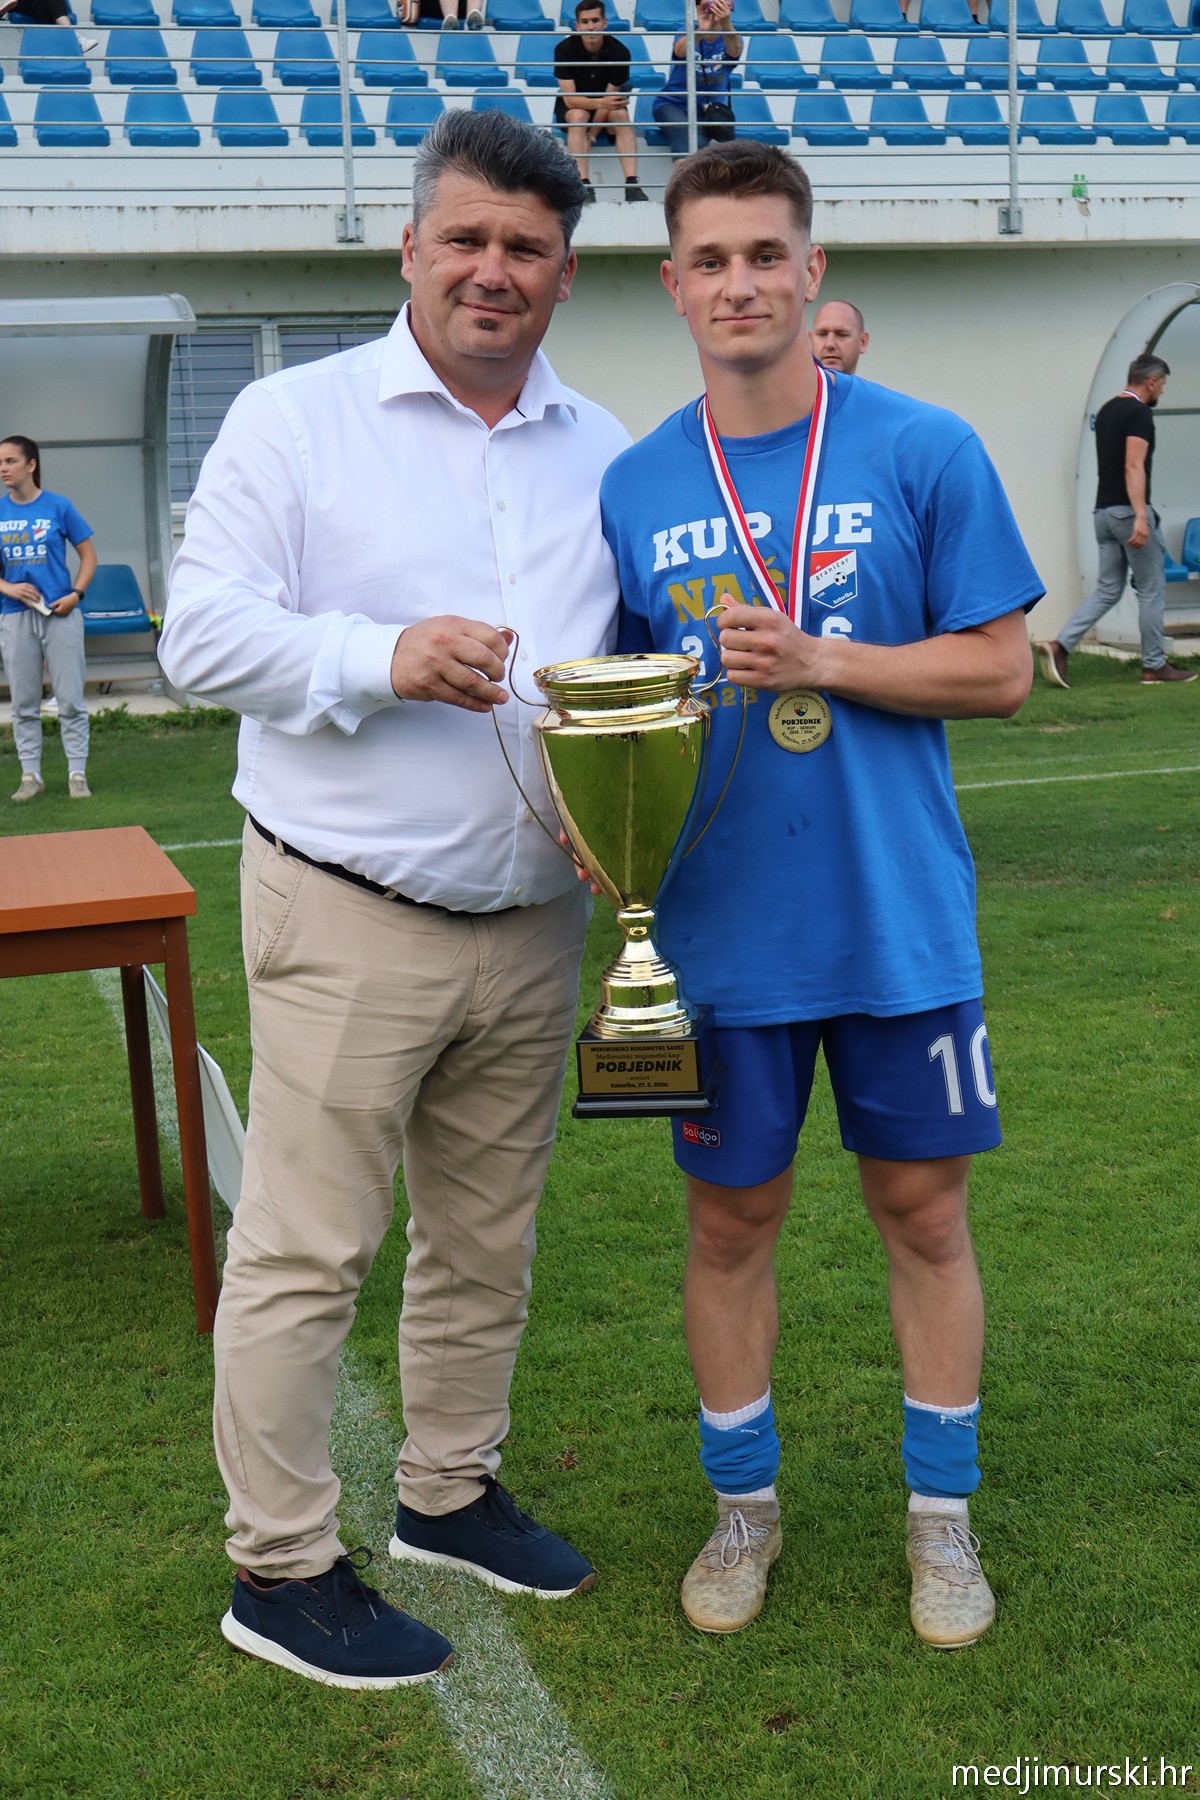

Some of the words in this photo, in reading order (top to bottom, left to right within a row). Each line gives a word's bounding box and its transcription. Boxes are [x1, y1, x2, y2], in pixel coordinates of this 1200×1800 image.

[0, 519, 28, 531] KUP
[31, 518, 51, 530] JE
[653, 511, 772, 572] KUP
[812, 502, 873, 546] JE
[815, 557, 849, 581] graničar
[782, 718, 821, 726] POBJEDNIK
[595, 1060, 683, 1073] POBJEDNIK
[927, 1022, 998, 1116] 10
[684, 1124, 718, 1145] balidoo
